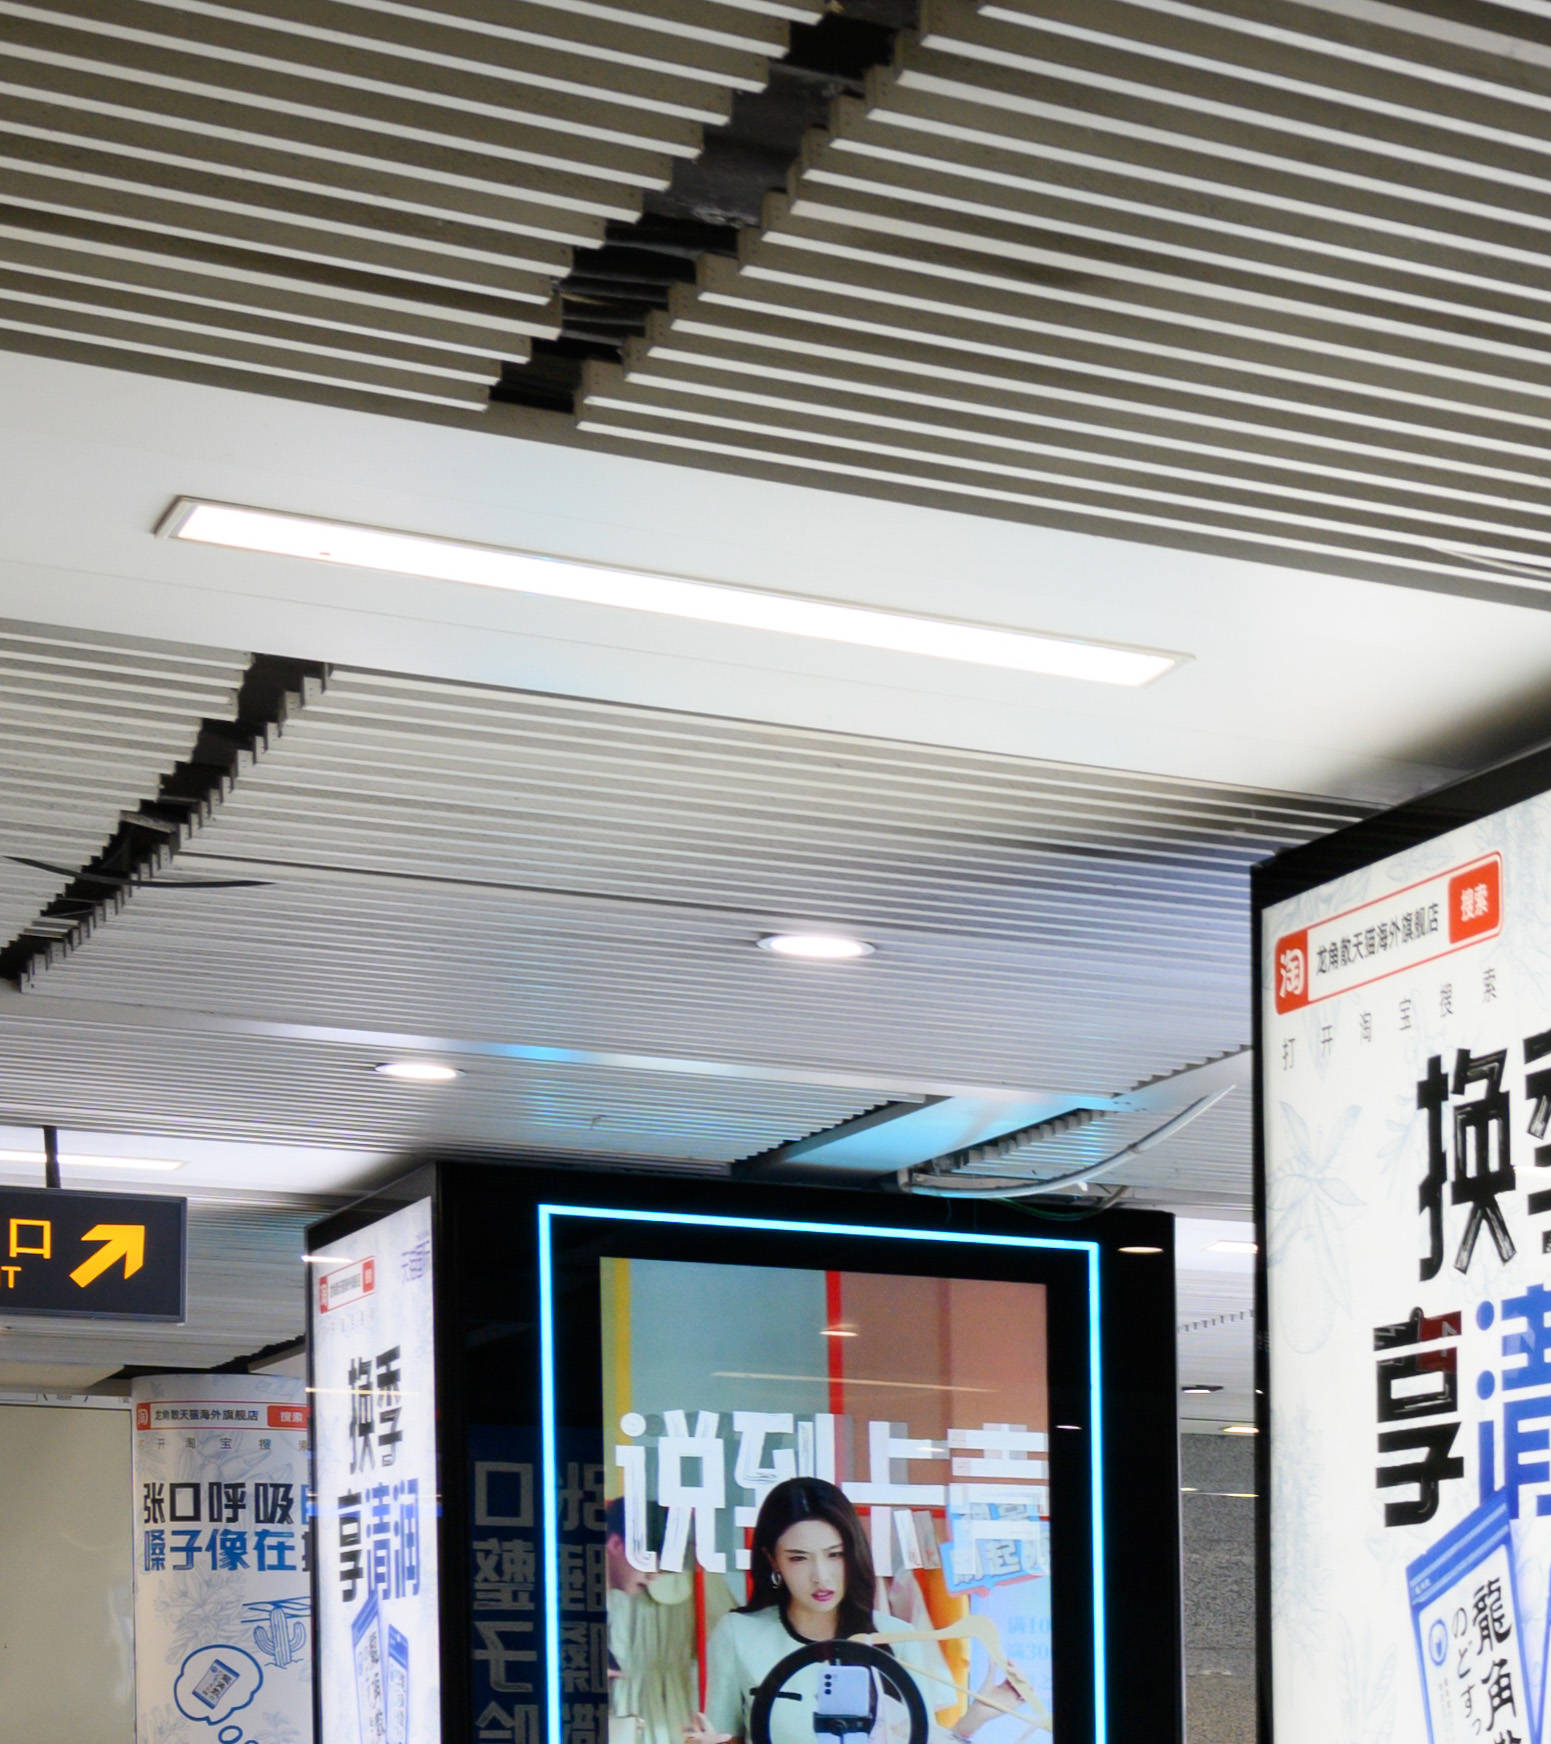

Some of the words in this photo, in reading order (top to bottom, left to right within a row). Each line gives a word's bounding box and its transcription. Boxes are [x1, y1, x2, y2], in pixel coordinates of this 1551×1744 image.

[1279, 948, 1305, 998] 淘
[9, 1218, 52, 1260] 口
[348, 1345, 403, 1476] 换季
[143, 1482, 311, 1525] 张口呼吸
[338, 1477, 421, 1603] 享清润
